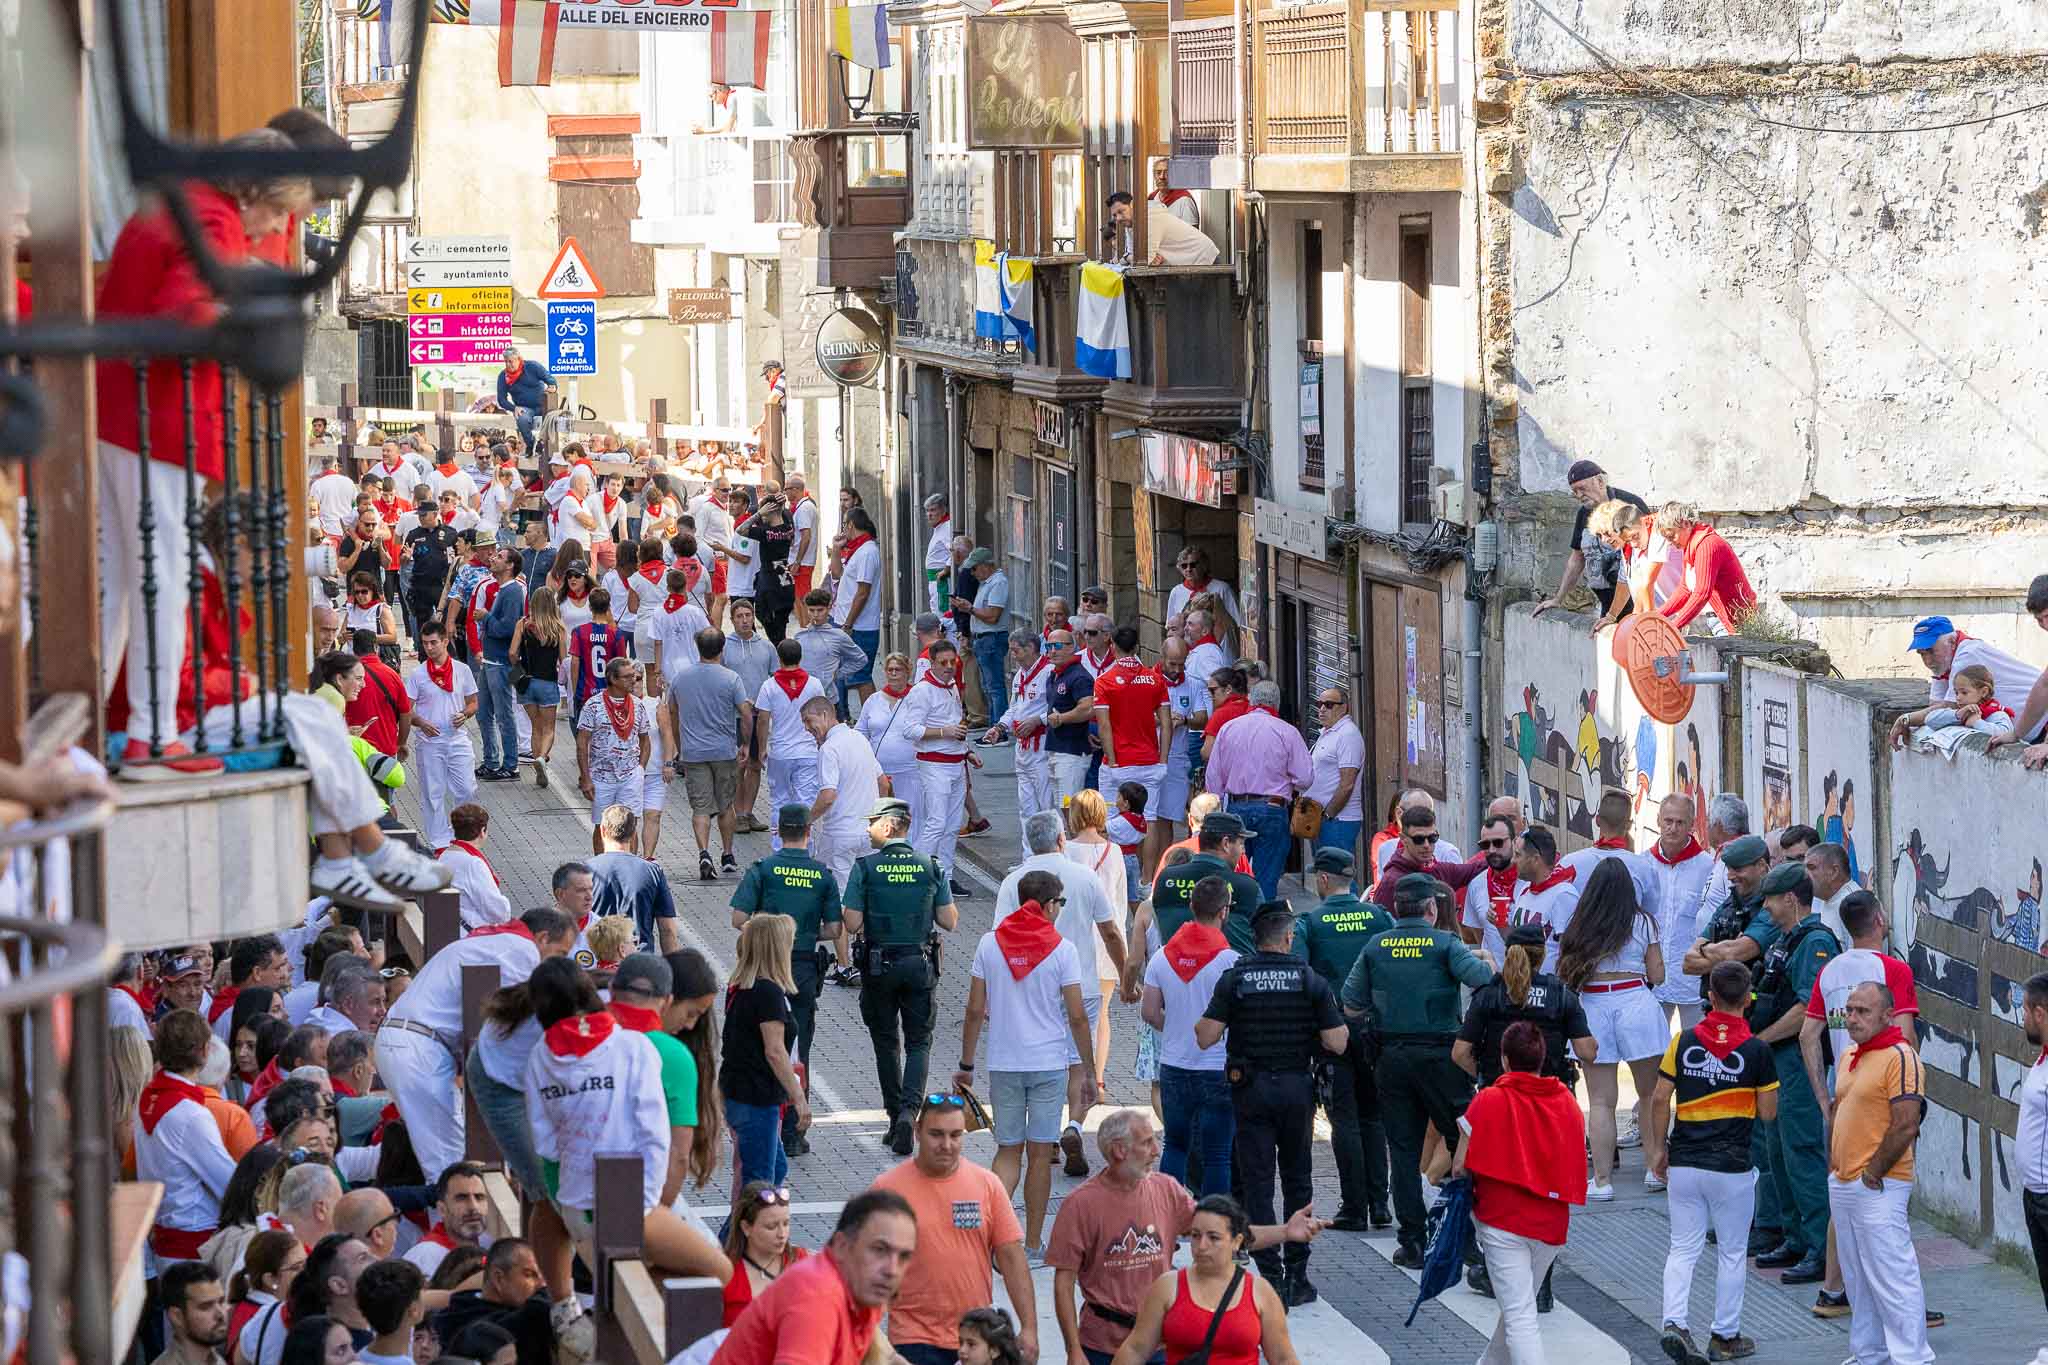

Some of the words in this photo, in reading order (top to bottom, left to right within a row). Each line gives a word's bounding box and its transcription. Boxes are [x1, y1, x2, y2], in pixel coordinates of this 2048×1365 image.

[560, 9, 596, 24] ALLE
[601, 10, 629, 25] DEL
[634, 11, 710, 26] ENCIERRO
[447, 243, 508, 253] cementerio
[443, 271, 509, 280] ayuntamiento
[472, 291, 509, 299] oficina
[549, 304, 593, 314] ATENCIÓN
[478, 315, 511, 323] casco
[460, 325, 511, 336] histórico
[474, 340, 511, 350] molino
[821, 341, 880, 356] GUINNESS
[589, 633, 608, 642] GAVI
[591, 644, 607, 678] 6
[773, 866, 822, 879] GUARDIA
[876, 864, 924, 873] GUARDIA
[784, 877, 813, 888] CIVIL
[887, 874, 916, 882] CIVIL
[1322, 911, 1374, 922] GUARDIA
[1335, 922, 1367, 932] CIVIL
[1380, 937, 1434, 947] GUARDIA
[1391, 948, 1423, 958] CIVIL
[1243, 970, 1300, 981] GUARDIA
[1256, 980, 1290, 990] CIVIL
[1716, 1073, 1739, 1082] TRAIL
